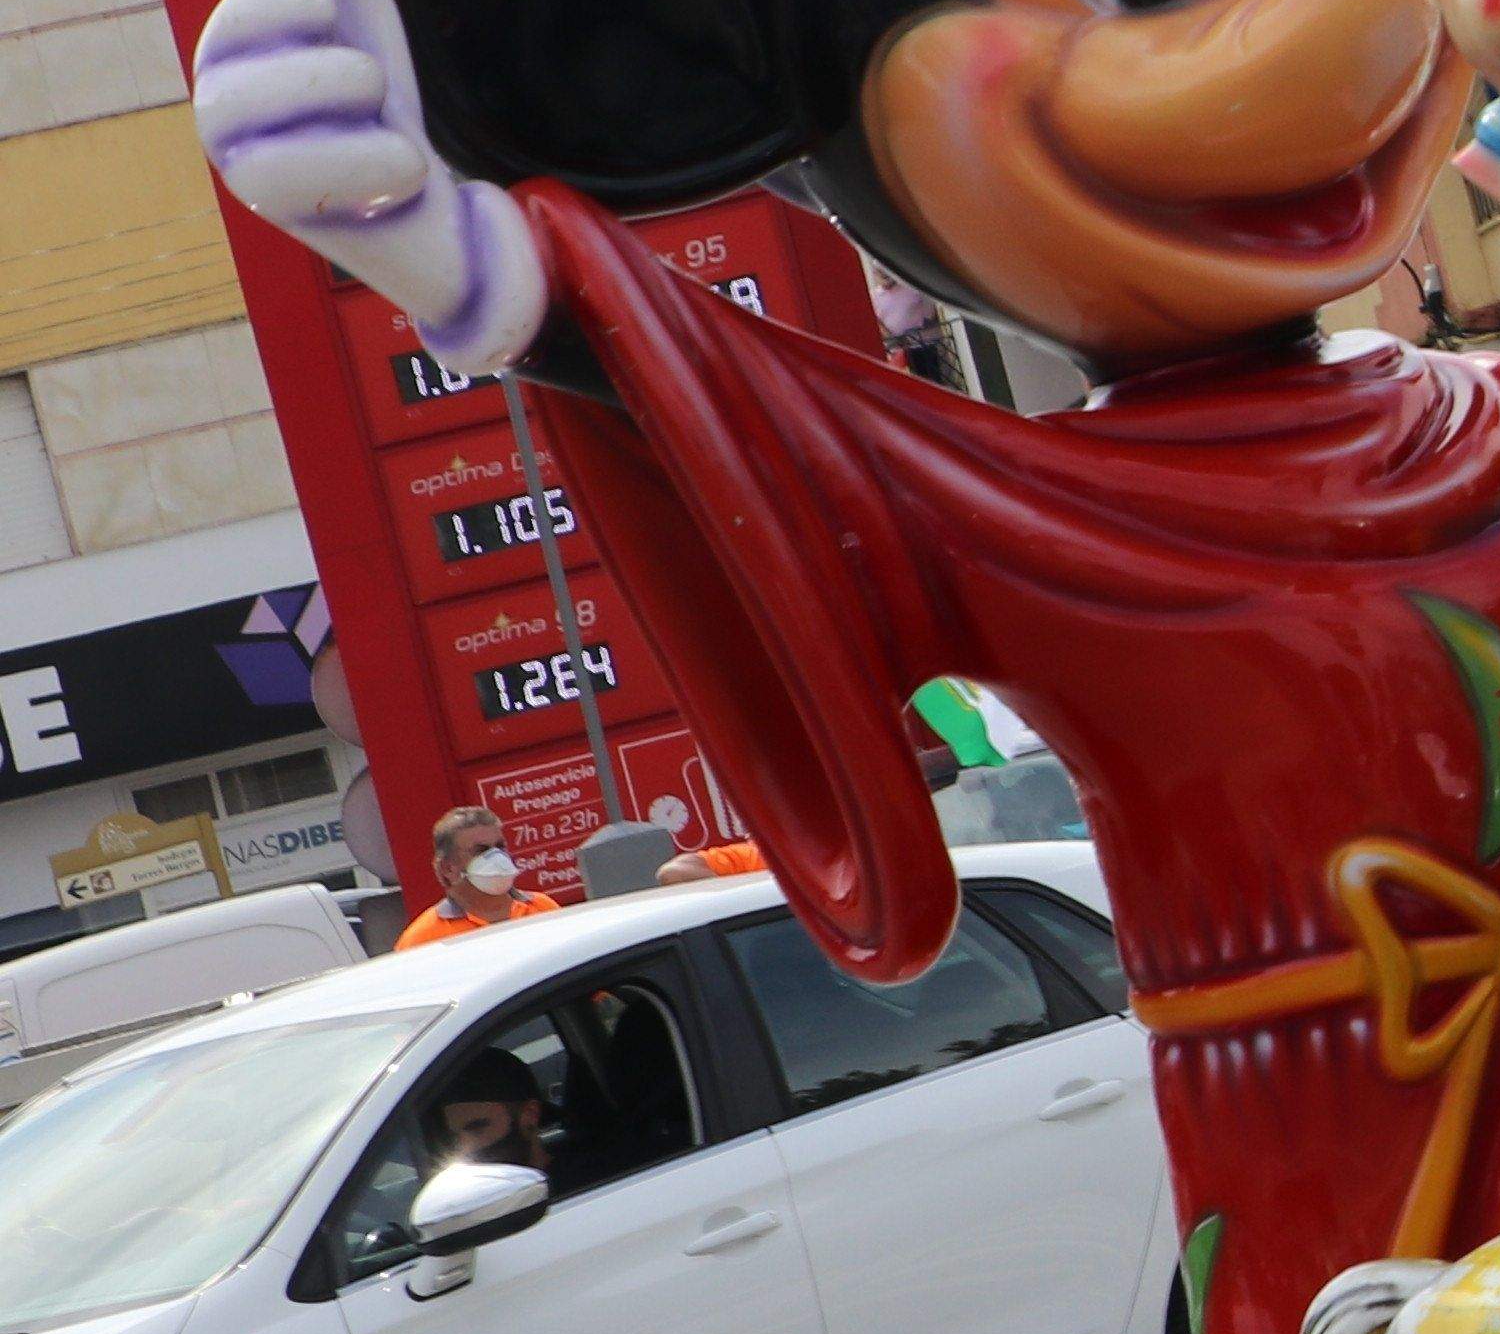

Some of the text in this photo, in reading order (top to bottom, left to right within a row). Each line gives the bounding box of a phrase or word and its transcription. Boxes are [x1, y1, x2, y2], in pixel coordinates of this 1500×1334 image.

[685, 234, 727, 268] 95
[409, 455, 503, 496] optima
[452, 488, 577, 554] 1.105
[454, 599, 597, 653] optima 8
[494, 765, 596, 799] Autoservicio
[512, 787, 581, 814] Prepago
[513, 809, 599, 847] 7h a 23h
